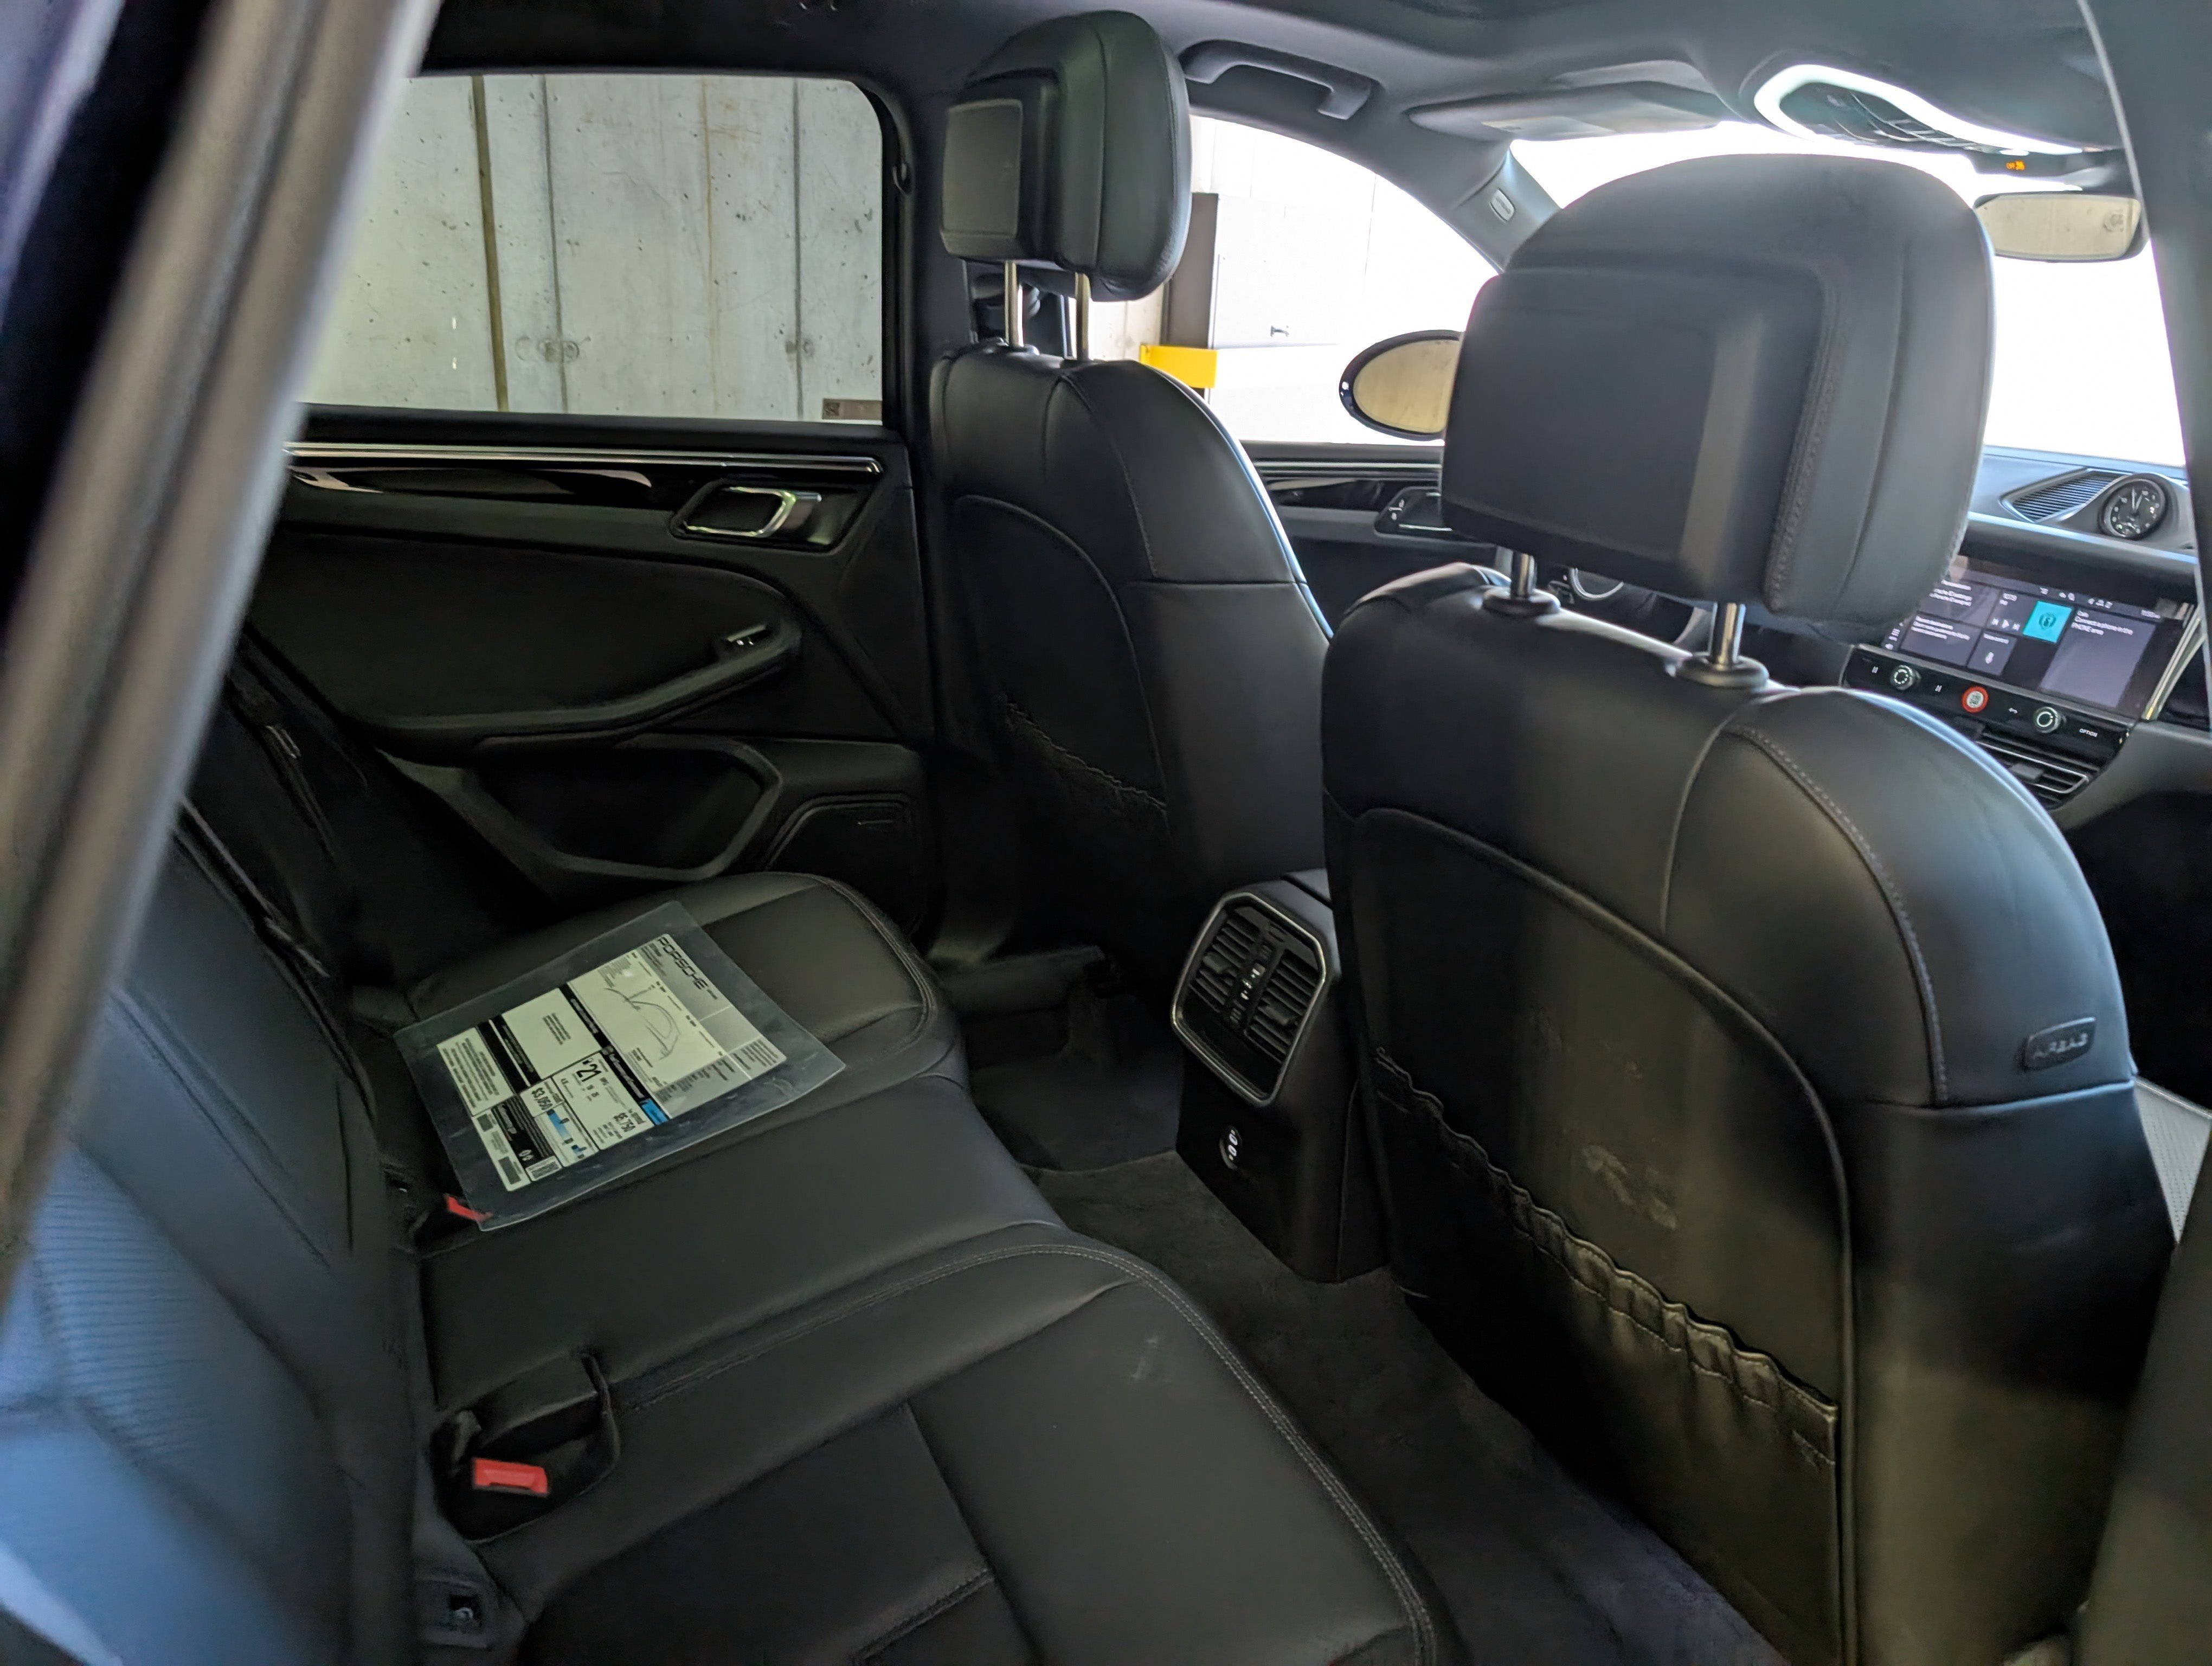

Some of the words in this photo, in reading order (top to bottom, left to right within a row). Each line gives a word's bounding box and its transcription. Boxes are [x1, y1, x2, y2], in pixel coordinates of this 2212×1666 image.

[2079, 728, 2098, 737] OPTION
[657, 937, 708, 990] PORSCHE
[576, 1063, 601, 1082] 21
